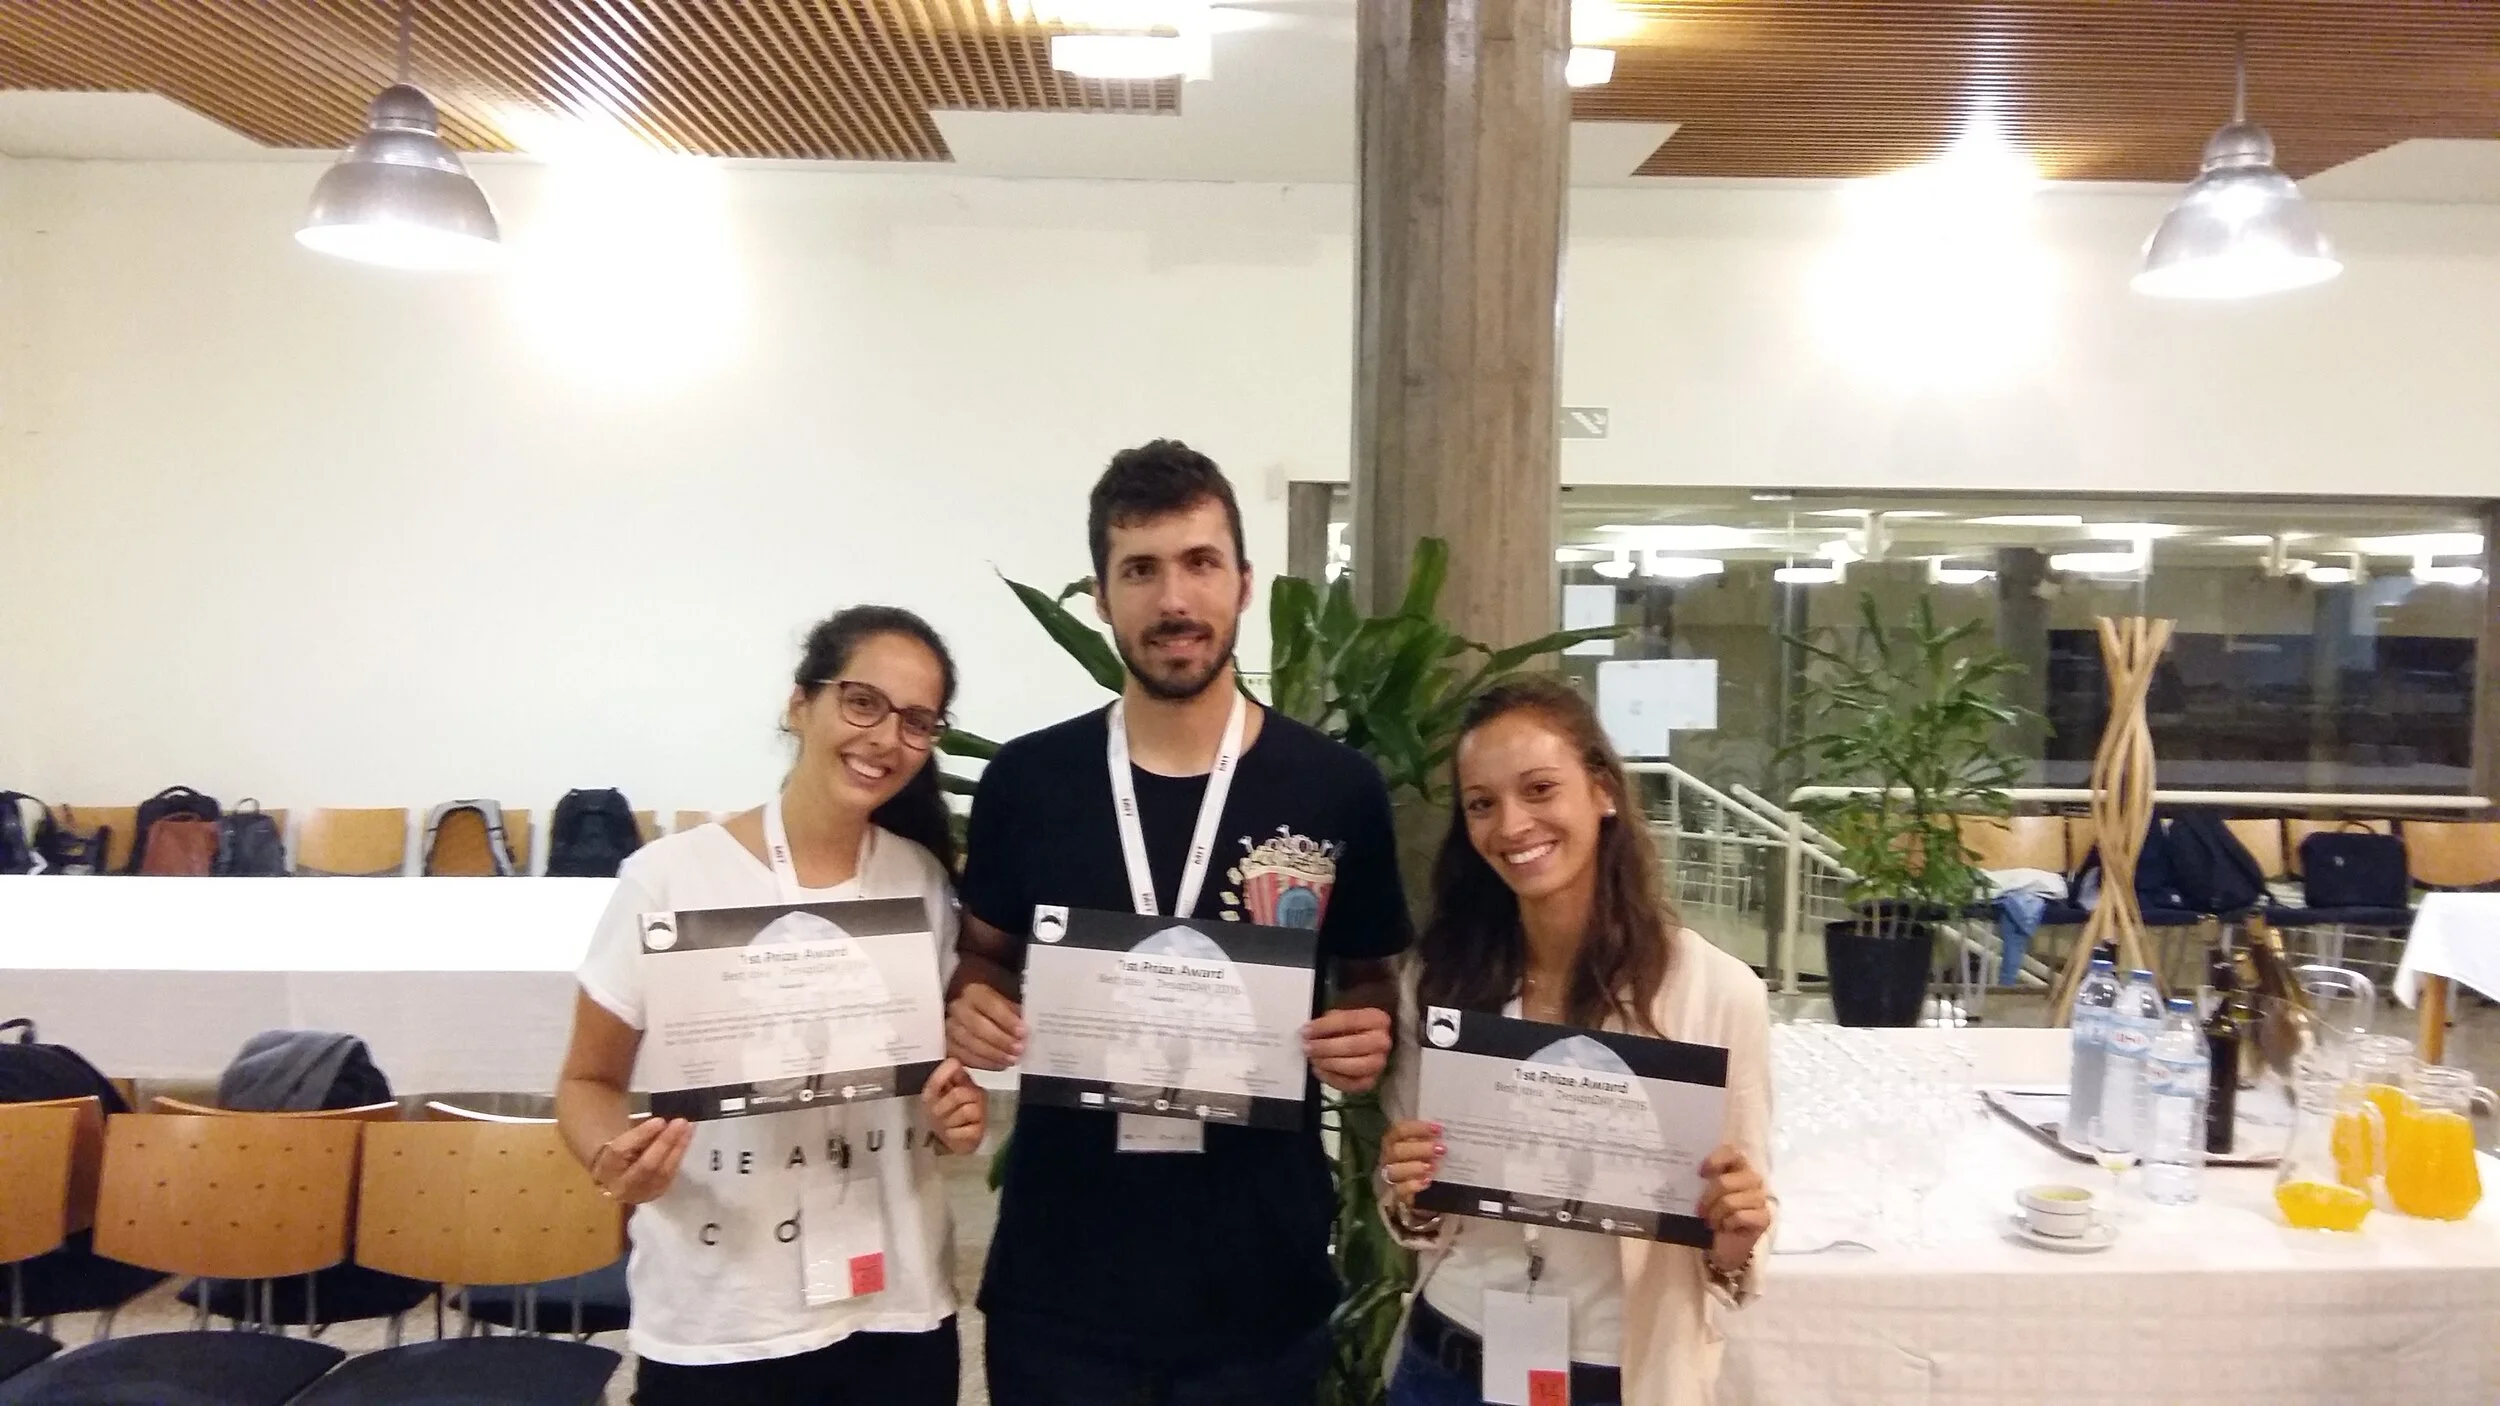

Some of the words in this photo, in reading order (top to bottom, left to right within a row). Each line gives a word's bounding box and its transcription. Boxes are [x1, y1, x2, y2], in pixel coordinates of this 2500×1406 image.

[764, 950, 799, 963] Prize
[803, 945, 848, 960] Award
[1118, 959, 1138, 972] 1st
[1142, 961, 1177, 975] Prize
[1179, 965, 1225, 979] Award
[1514, 1067, 1537, 1082] 1st
[1539, 1070, 1578, 1087] Prize
[1579, 1076, 1629, 1094] Award
